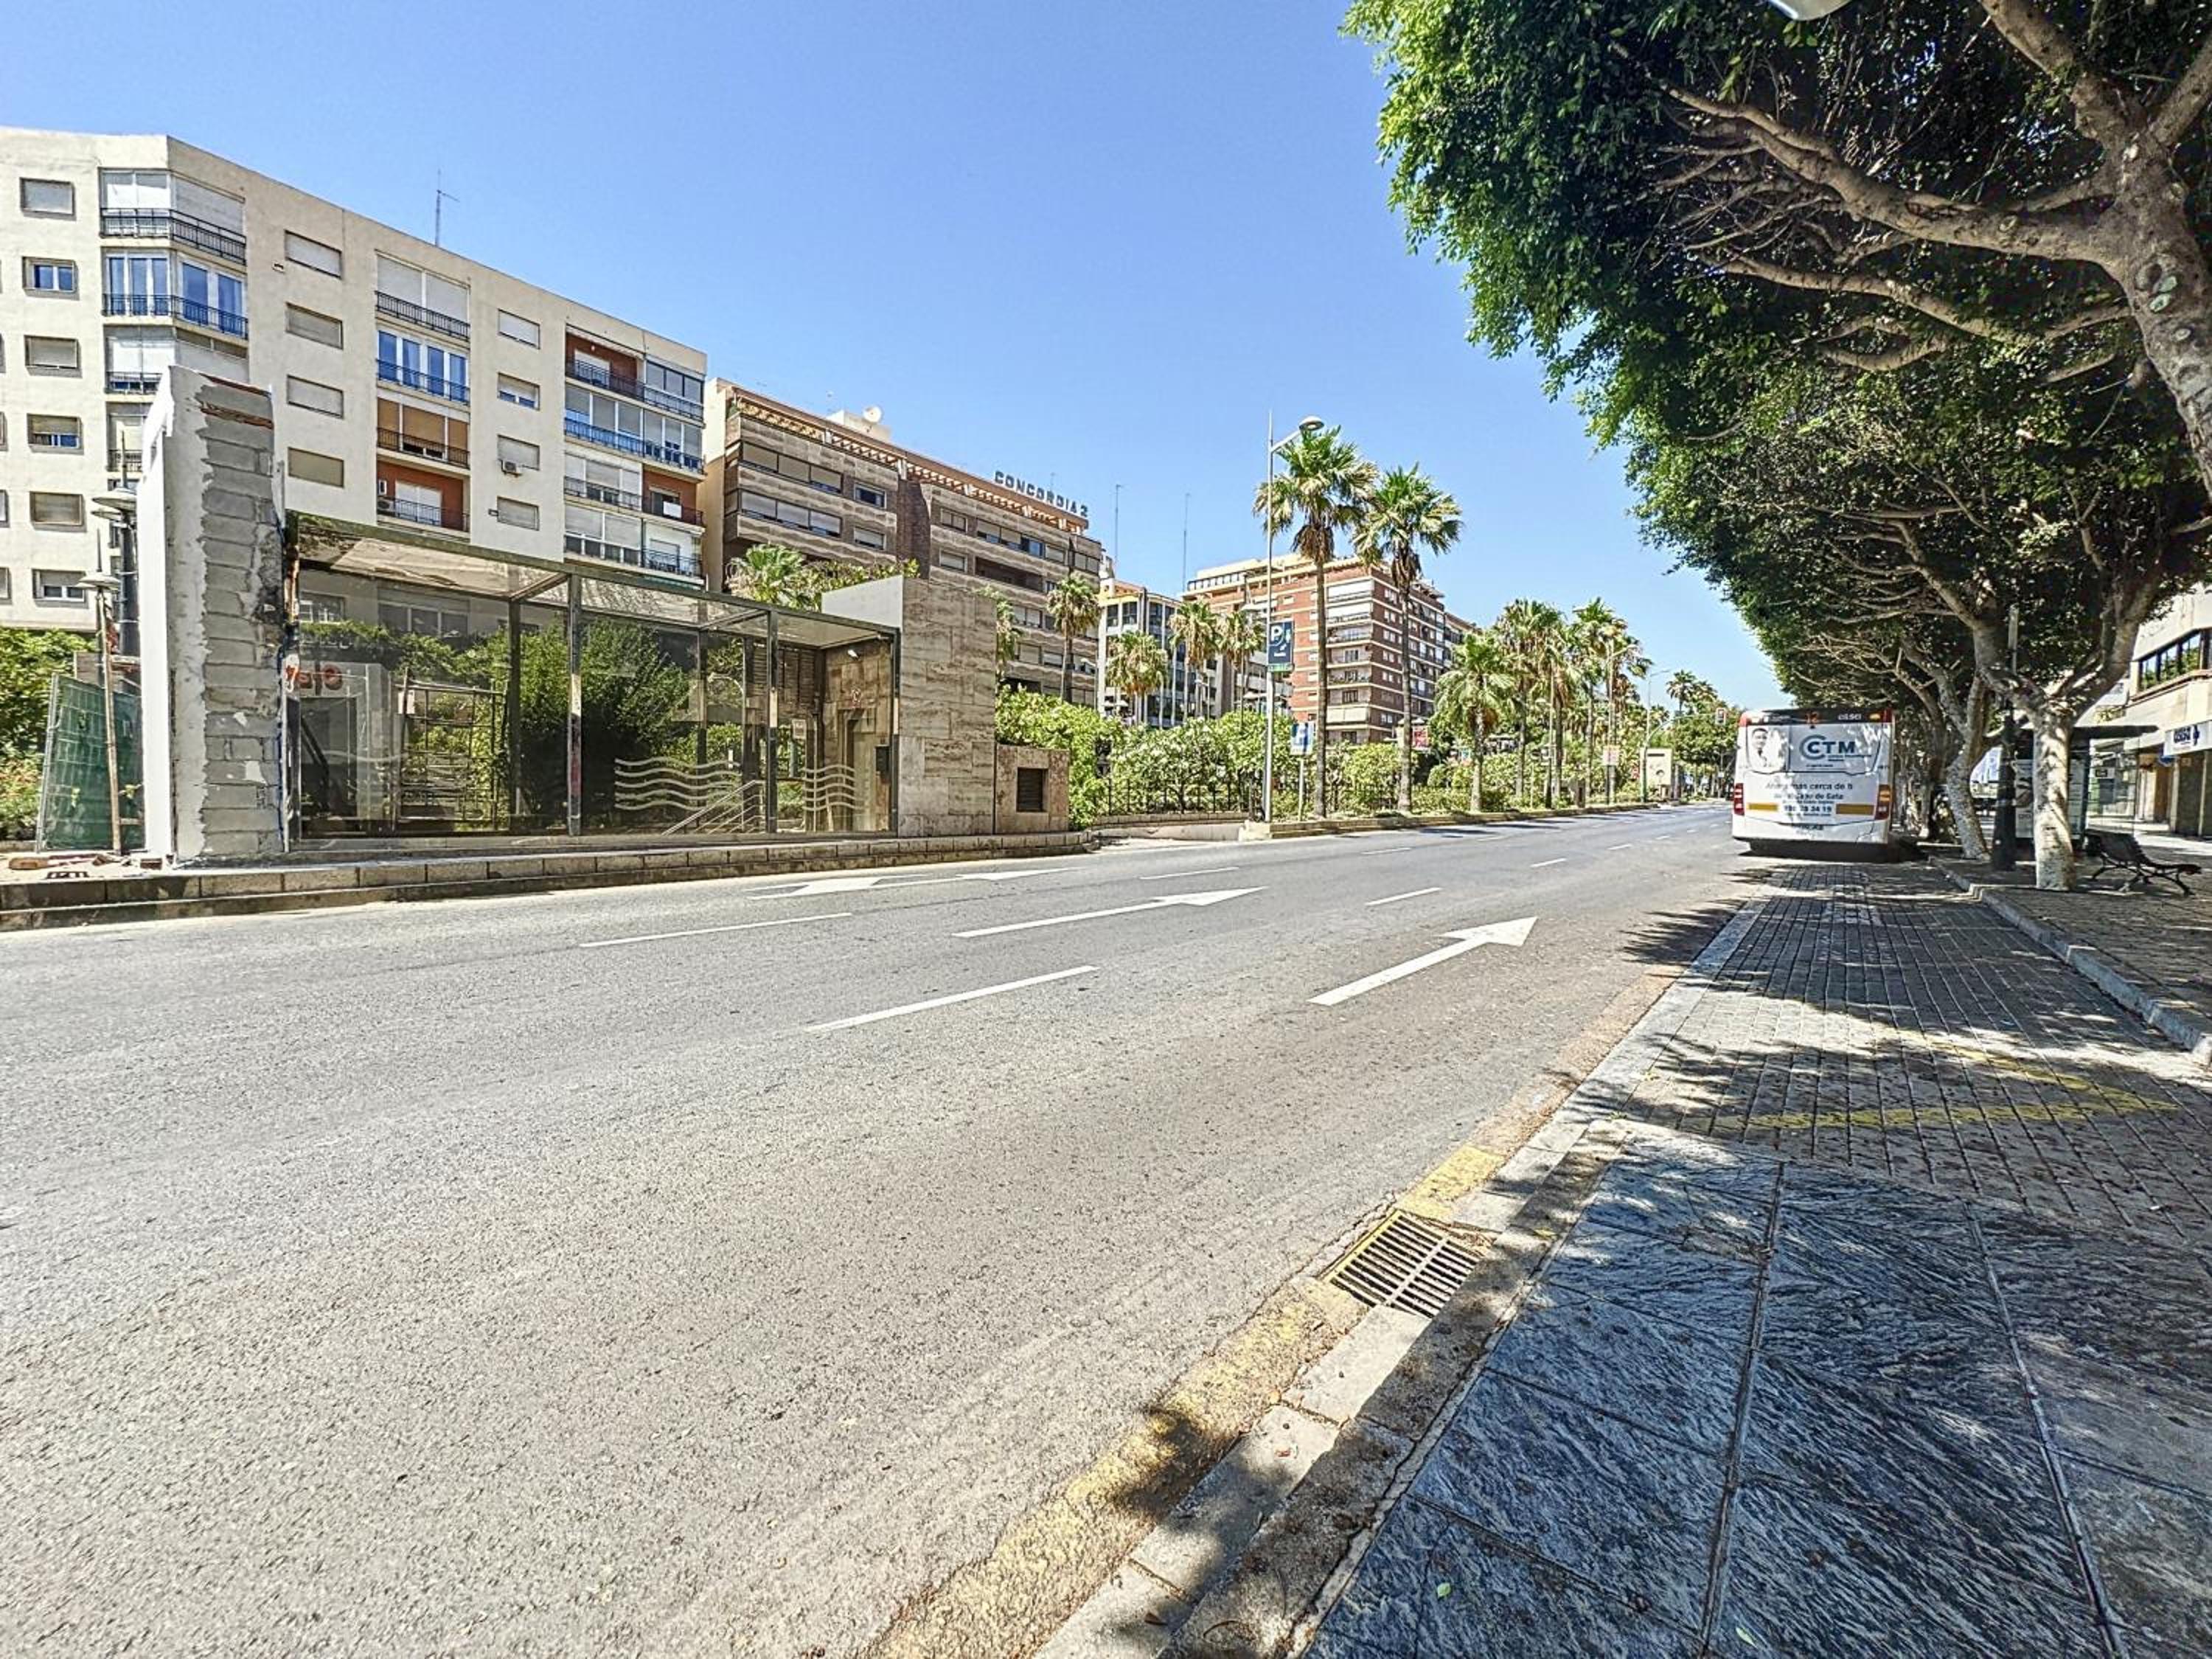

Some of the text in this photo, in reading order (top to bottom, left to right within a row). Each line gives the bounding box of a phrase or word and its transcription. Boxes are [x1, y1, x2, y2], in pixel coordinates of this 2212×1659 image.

[995, 470, 1088, 518] CONCORDIA 2
[1271, 625, 1283, 641] P
